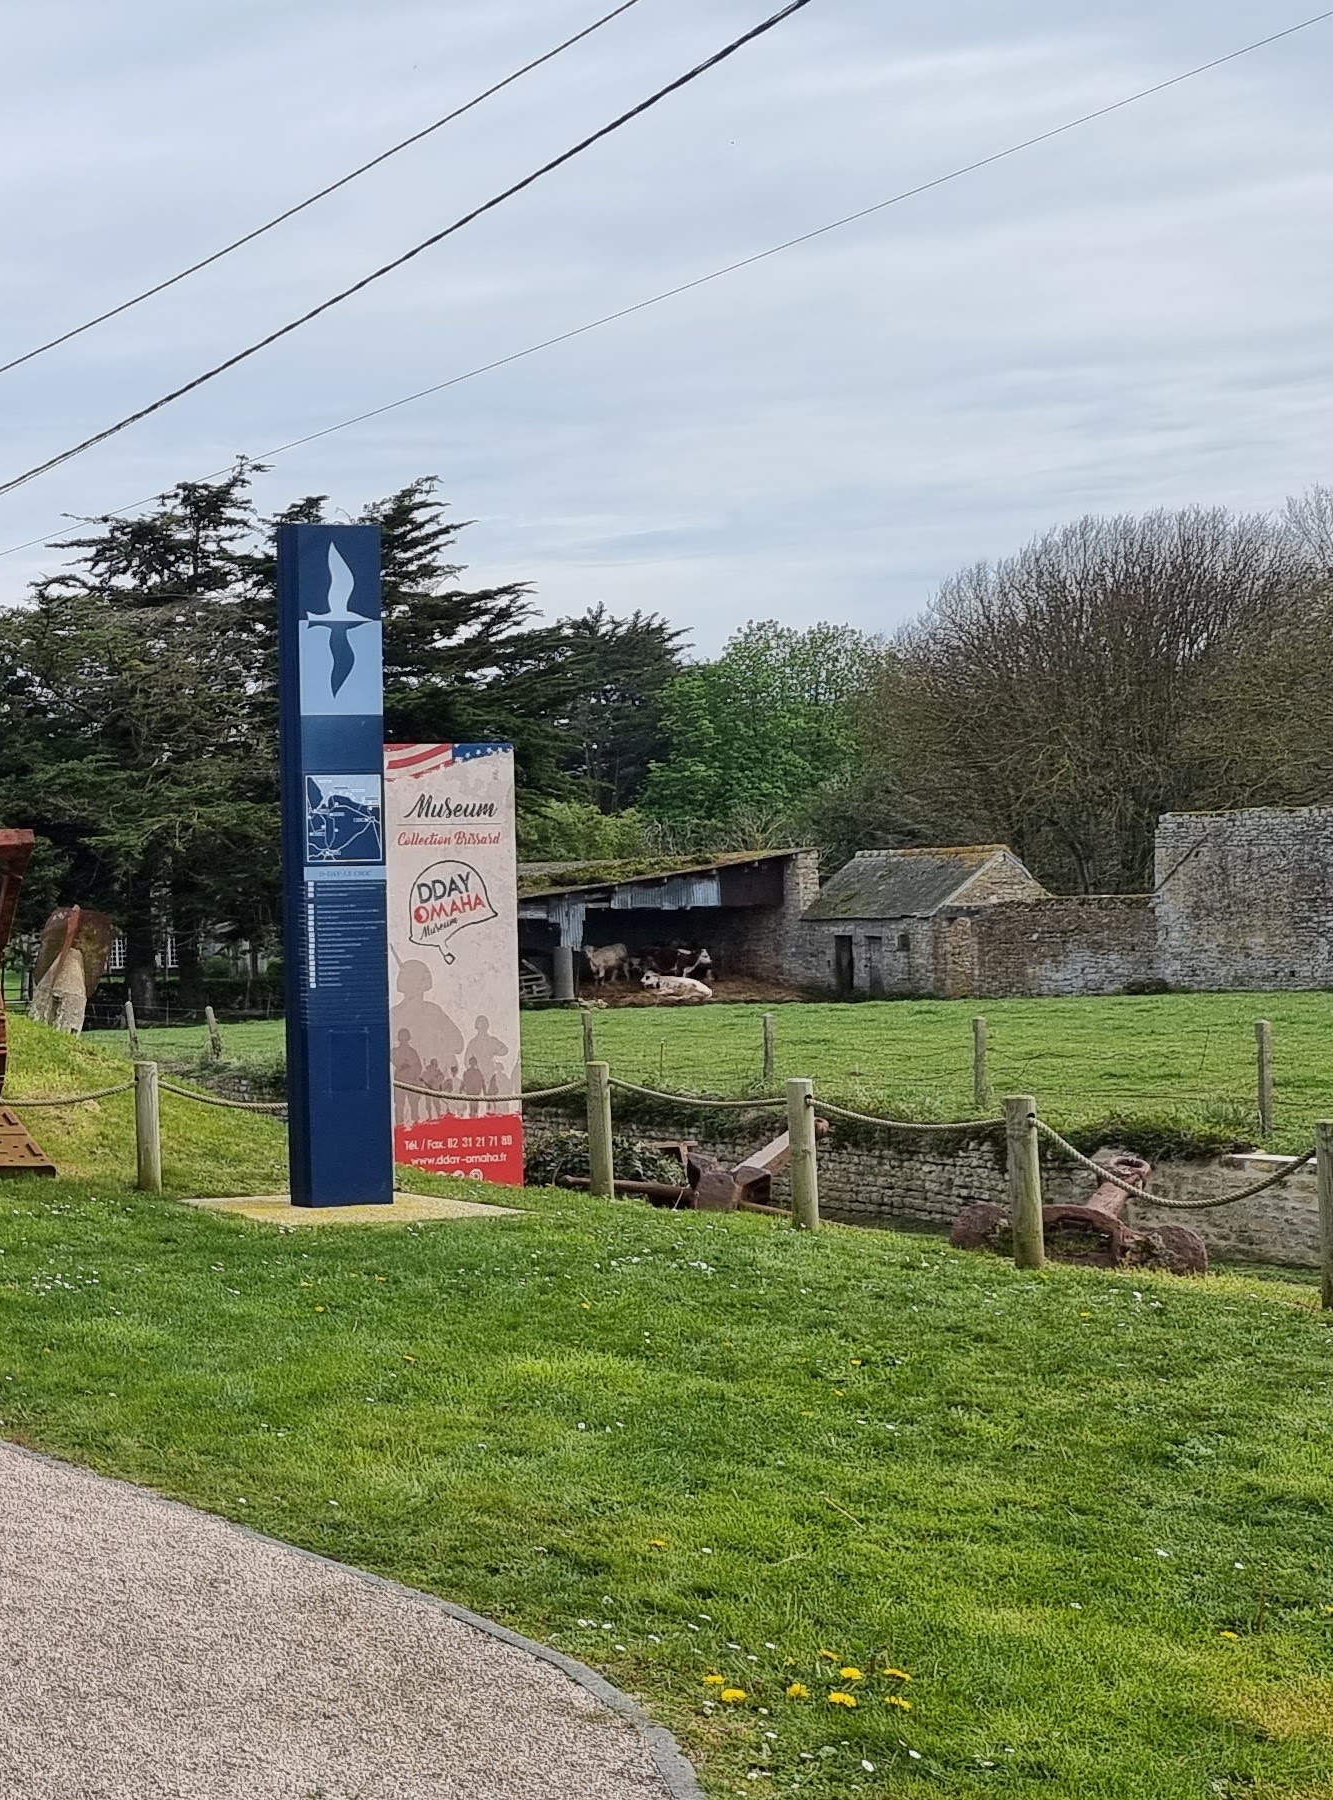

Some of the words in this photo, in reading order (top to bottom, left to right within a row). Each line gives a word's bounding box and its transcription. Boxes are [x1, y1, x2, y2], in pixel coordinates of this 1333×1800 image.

[403, 793, 498, 818] Museum
[397, 832, 451, 846] Collection
[454, 831, 501, 845] Brissard
[417, 871, 470, 904] DDAY
[414, 893, 486, 923] OMAHA
[420, 917, 458, 940] Museum
[447, 1138, 459, 1149] 02
[462, 1137, 473, 1148] 31
[476, 1136, 485, 1147] 21
[489, 1135, 498, 1146] 71
